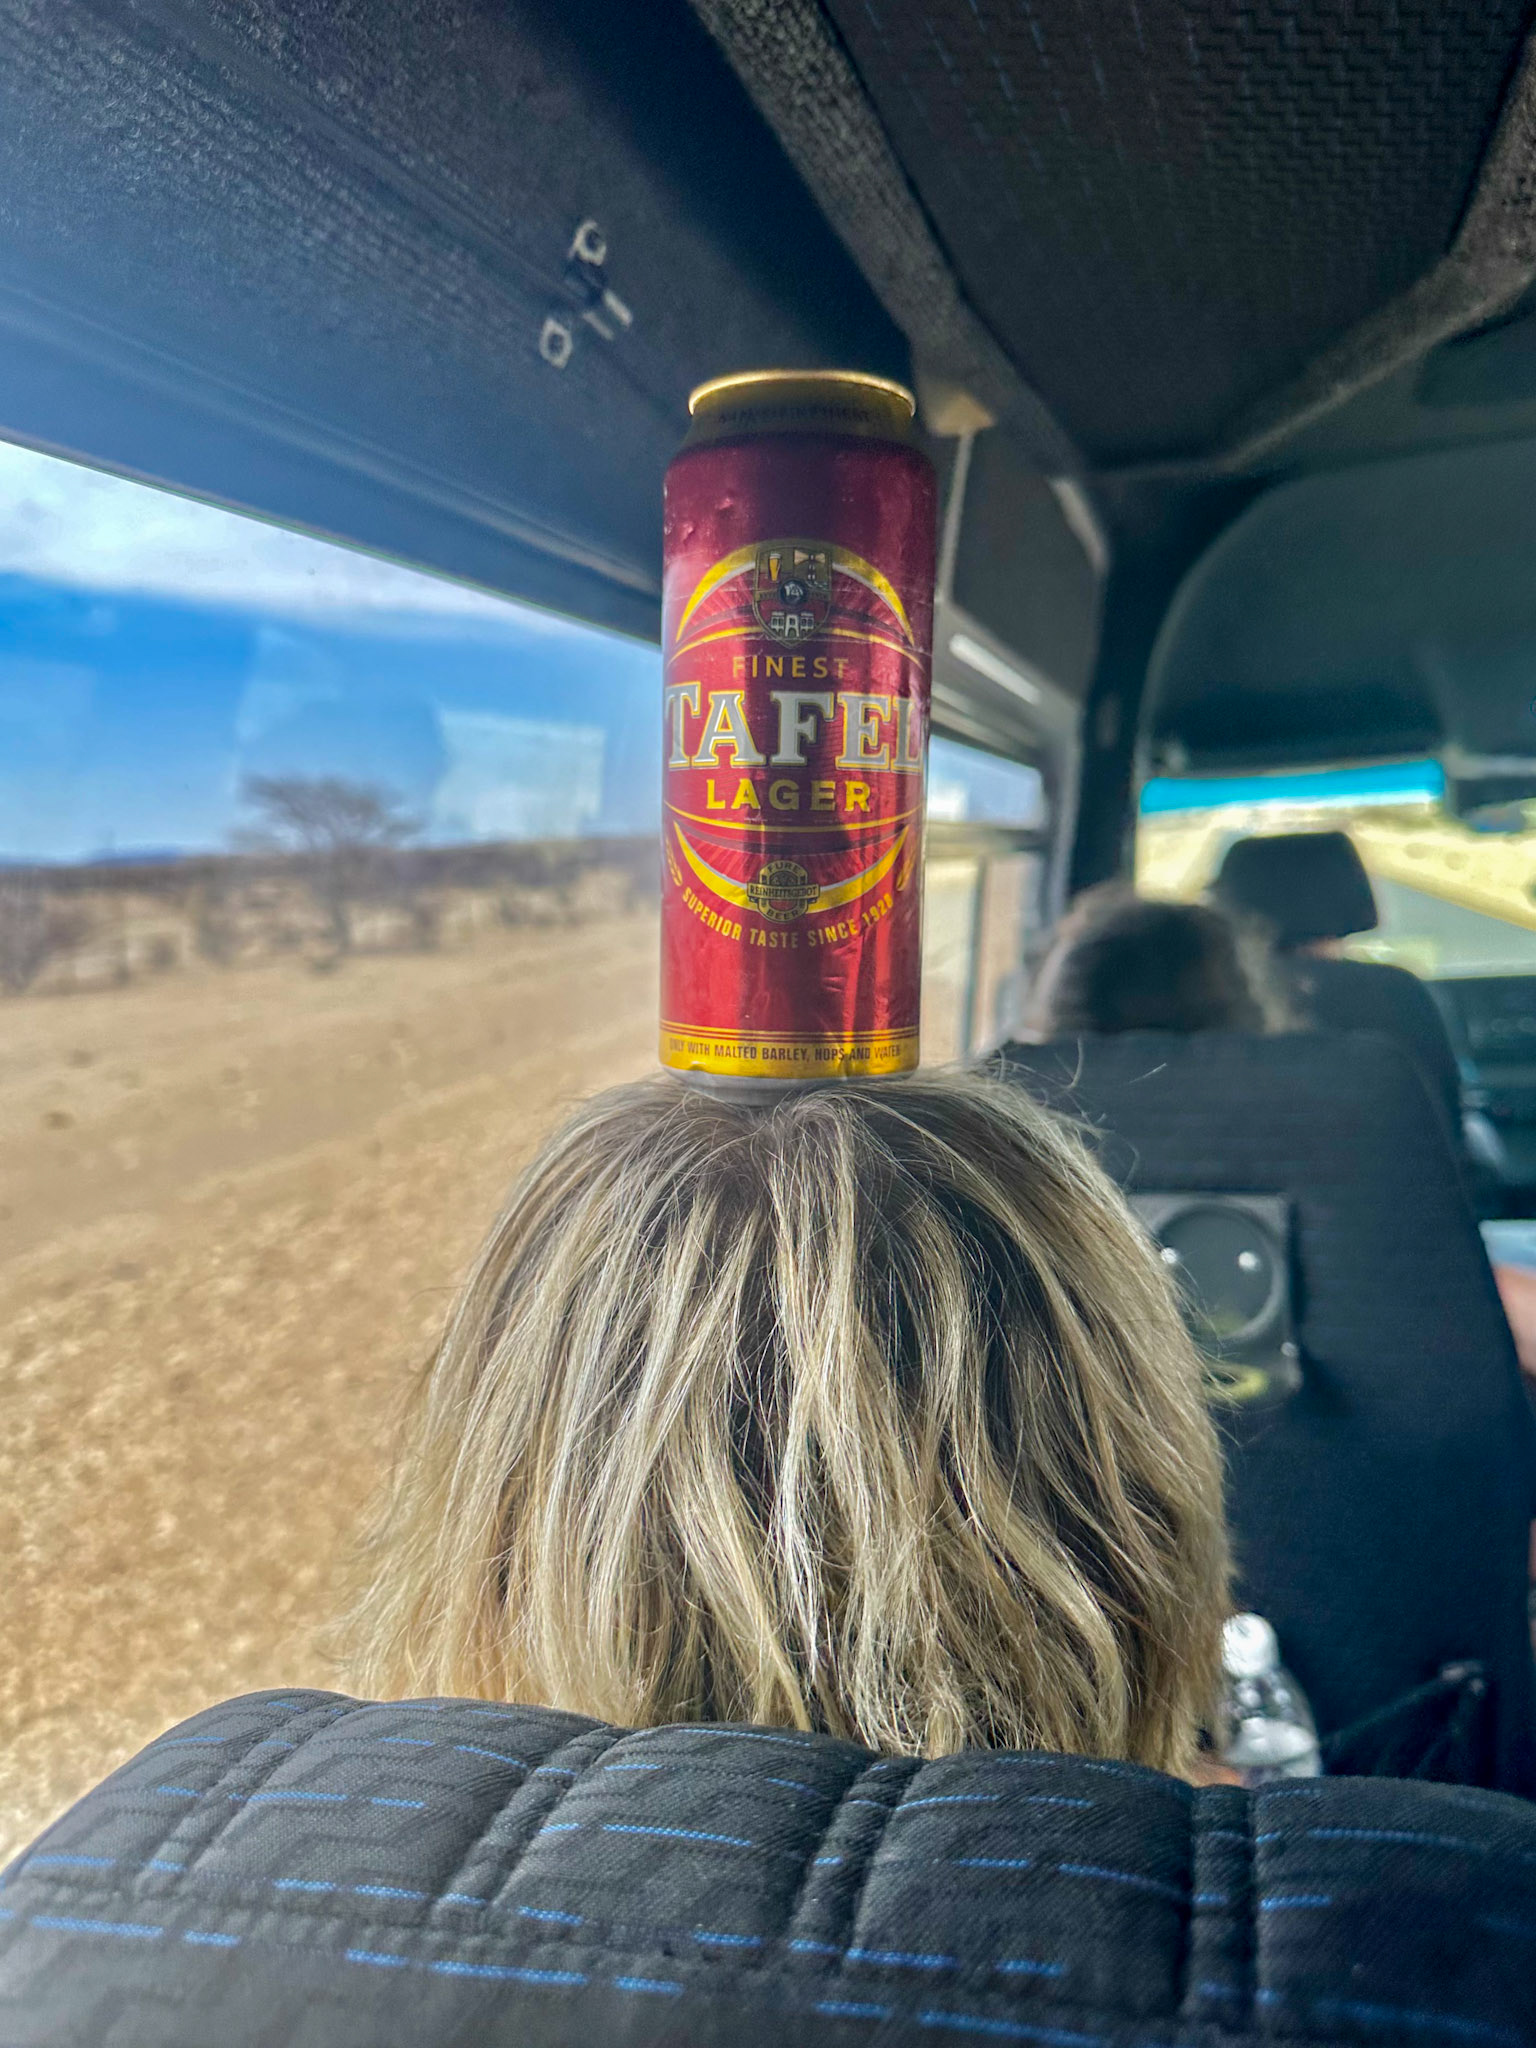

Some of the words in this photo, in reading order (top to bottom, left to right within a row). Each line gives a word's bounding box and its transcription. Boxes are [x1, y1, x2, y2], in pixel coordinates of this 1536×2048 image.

[732, 656, 849, 679] FINEST
[706, 777, 871, 813] LAGER
[682, 886, 743, 942] SUPERIOR
[750, 927, 799, 949] TASTE
[807, 918, 858, 947] SINCE
[687, 1041, 711, 1057] WITH
[714, 1044, 757, 1060] MALTED
[762, 1047, 810, 1063] BARLEY,
[815, 1047, 846, 1062] HOPS
[849, 1047, 871, 1061] AND
